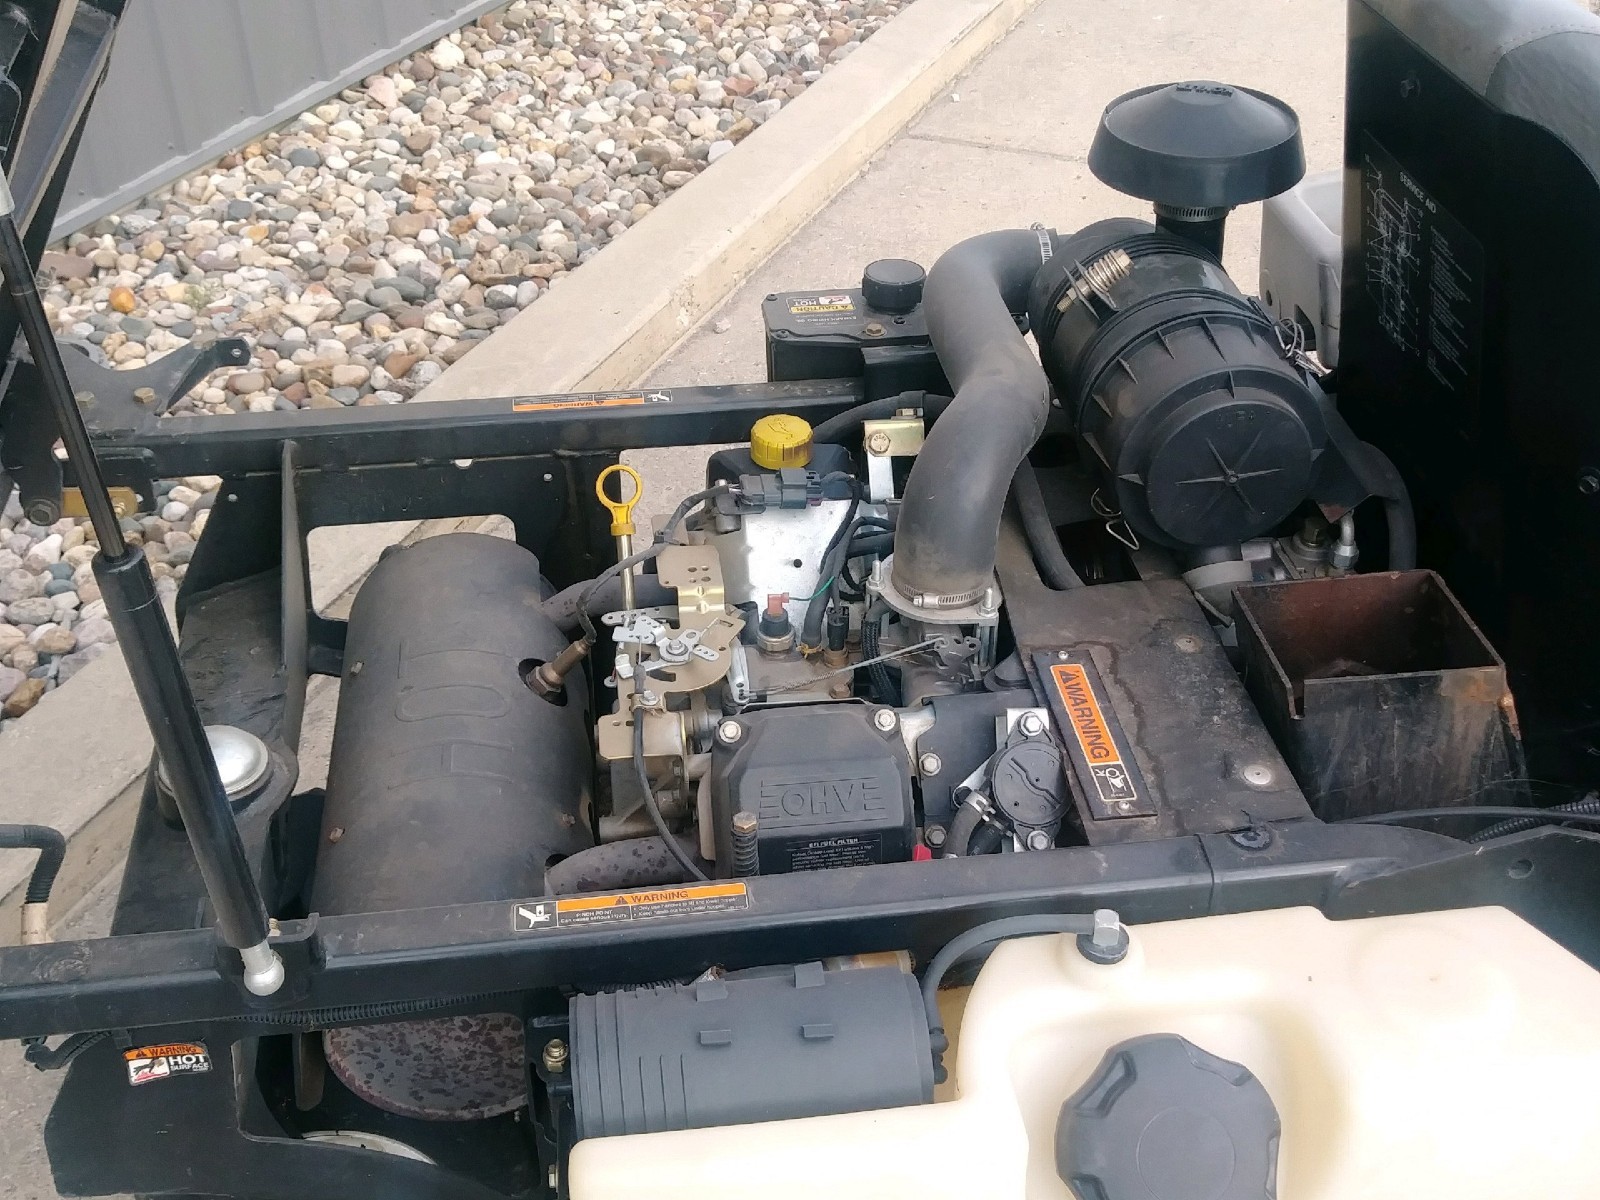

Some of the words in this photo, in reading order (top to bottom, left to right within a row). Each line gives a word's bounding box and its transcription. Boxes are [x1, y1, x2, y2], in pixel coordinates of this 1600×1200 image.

[1399, 171, 1424, 203] SERVICE
[1425, 198, 1437, 213] AID
[1064, 683, 1111, 760] WARNING
[630, 890, 689, 904] WARNING
[149, 1045, 197, 1057] WARNING
[168, 1054, 206, 1066] HOT
[170, 1062, 209, 1071] SURFACE
